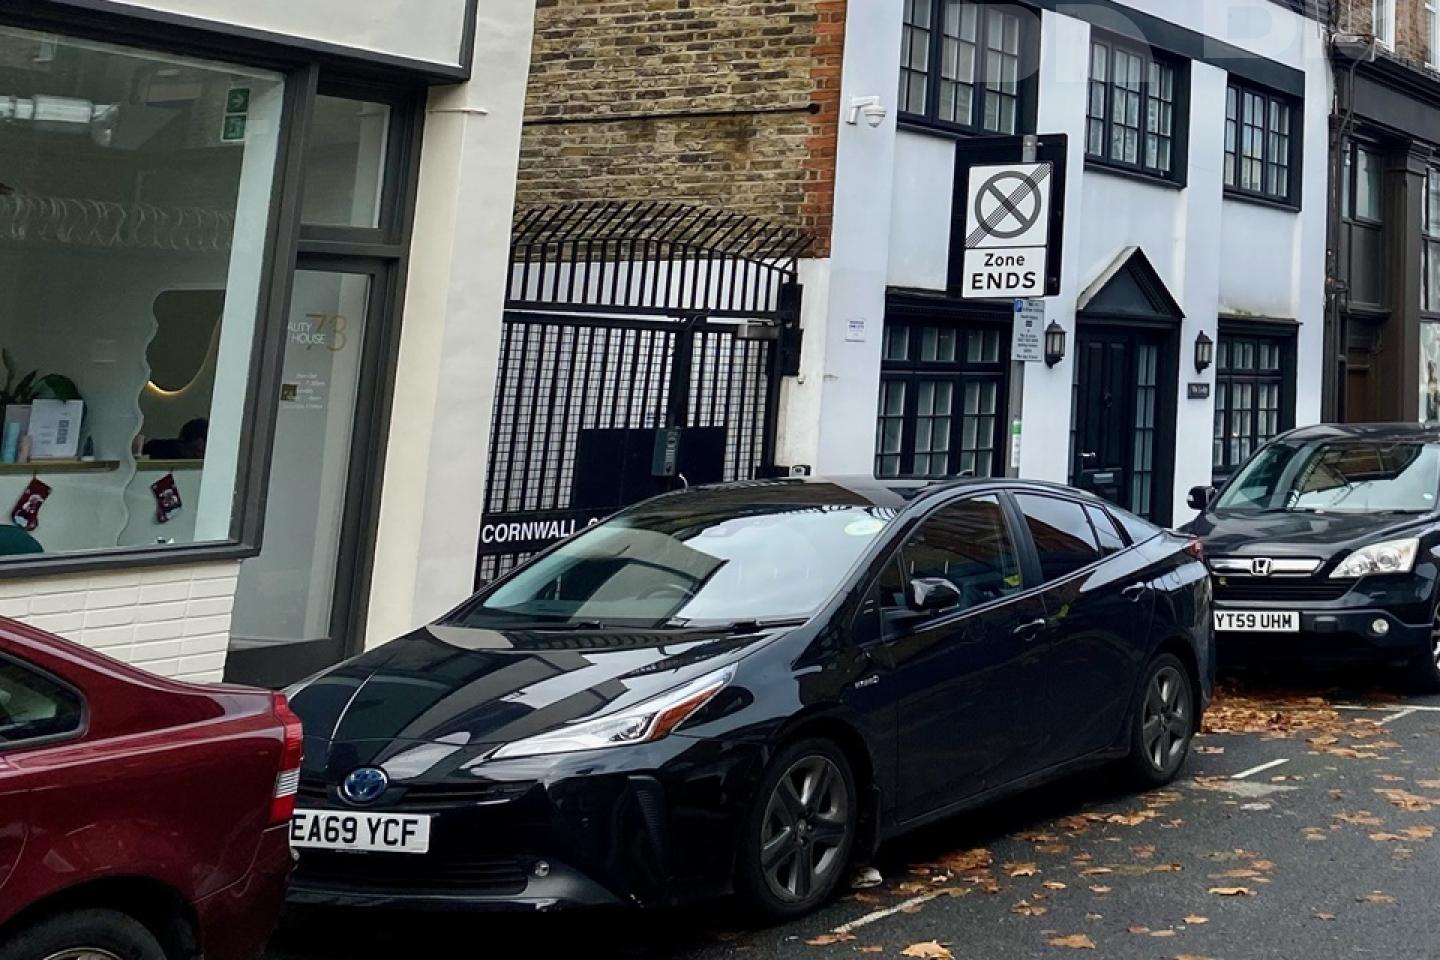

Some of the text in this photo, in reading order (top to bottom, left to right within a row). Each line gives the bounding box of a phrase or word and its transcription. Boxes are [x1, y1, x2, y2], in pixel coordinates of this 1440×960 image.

[984, 253, 1025, 267] Zone
[972, 271, 1036, 290] ENDS
[1216, 613, 1292, 628] YT59 UHM
[291, 814, 418, 846] EA69 YCF
